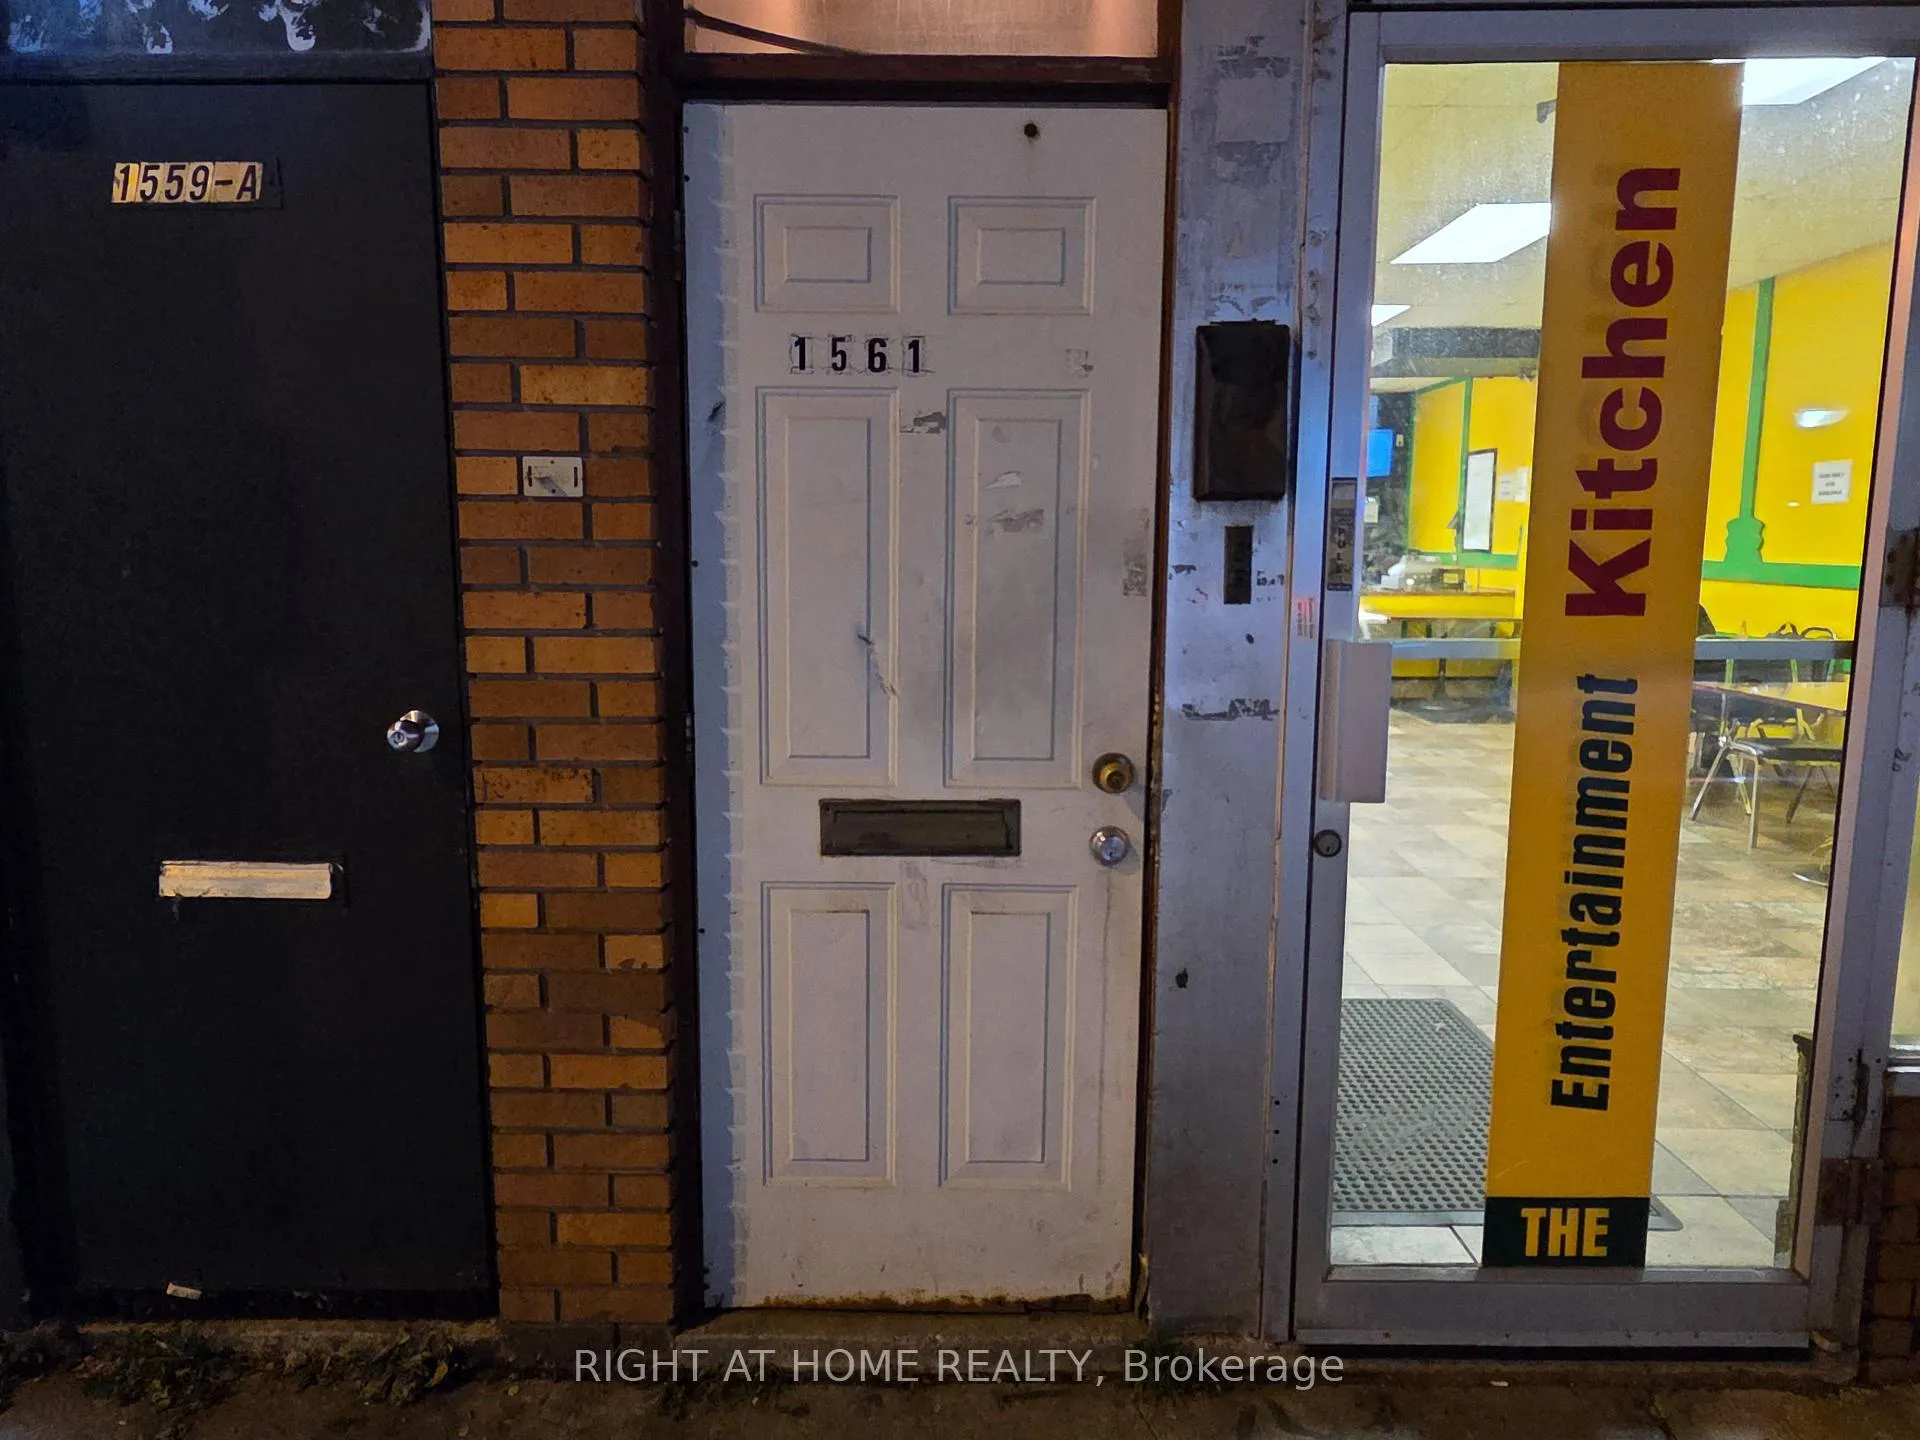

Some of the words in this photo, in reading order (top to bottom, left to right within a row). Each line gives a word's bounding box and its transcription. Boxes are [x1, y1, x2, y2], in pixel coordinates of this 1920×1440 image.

[117, 164, 257, 201] 1559-A
[794, 336, 920, 374] 1561
[1564, 167, 1681, 617] Kitchen
[1550, 672, 1640, 1112] Entertainment
[1520, 1207, 1608, 1258] THE
